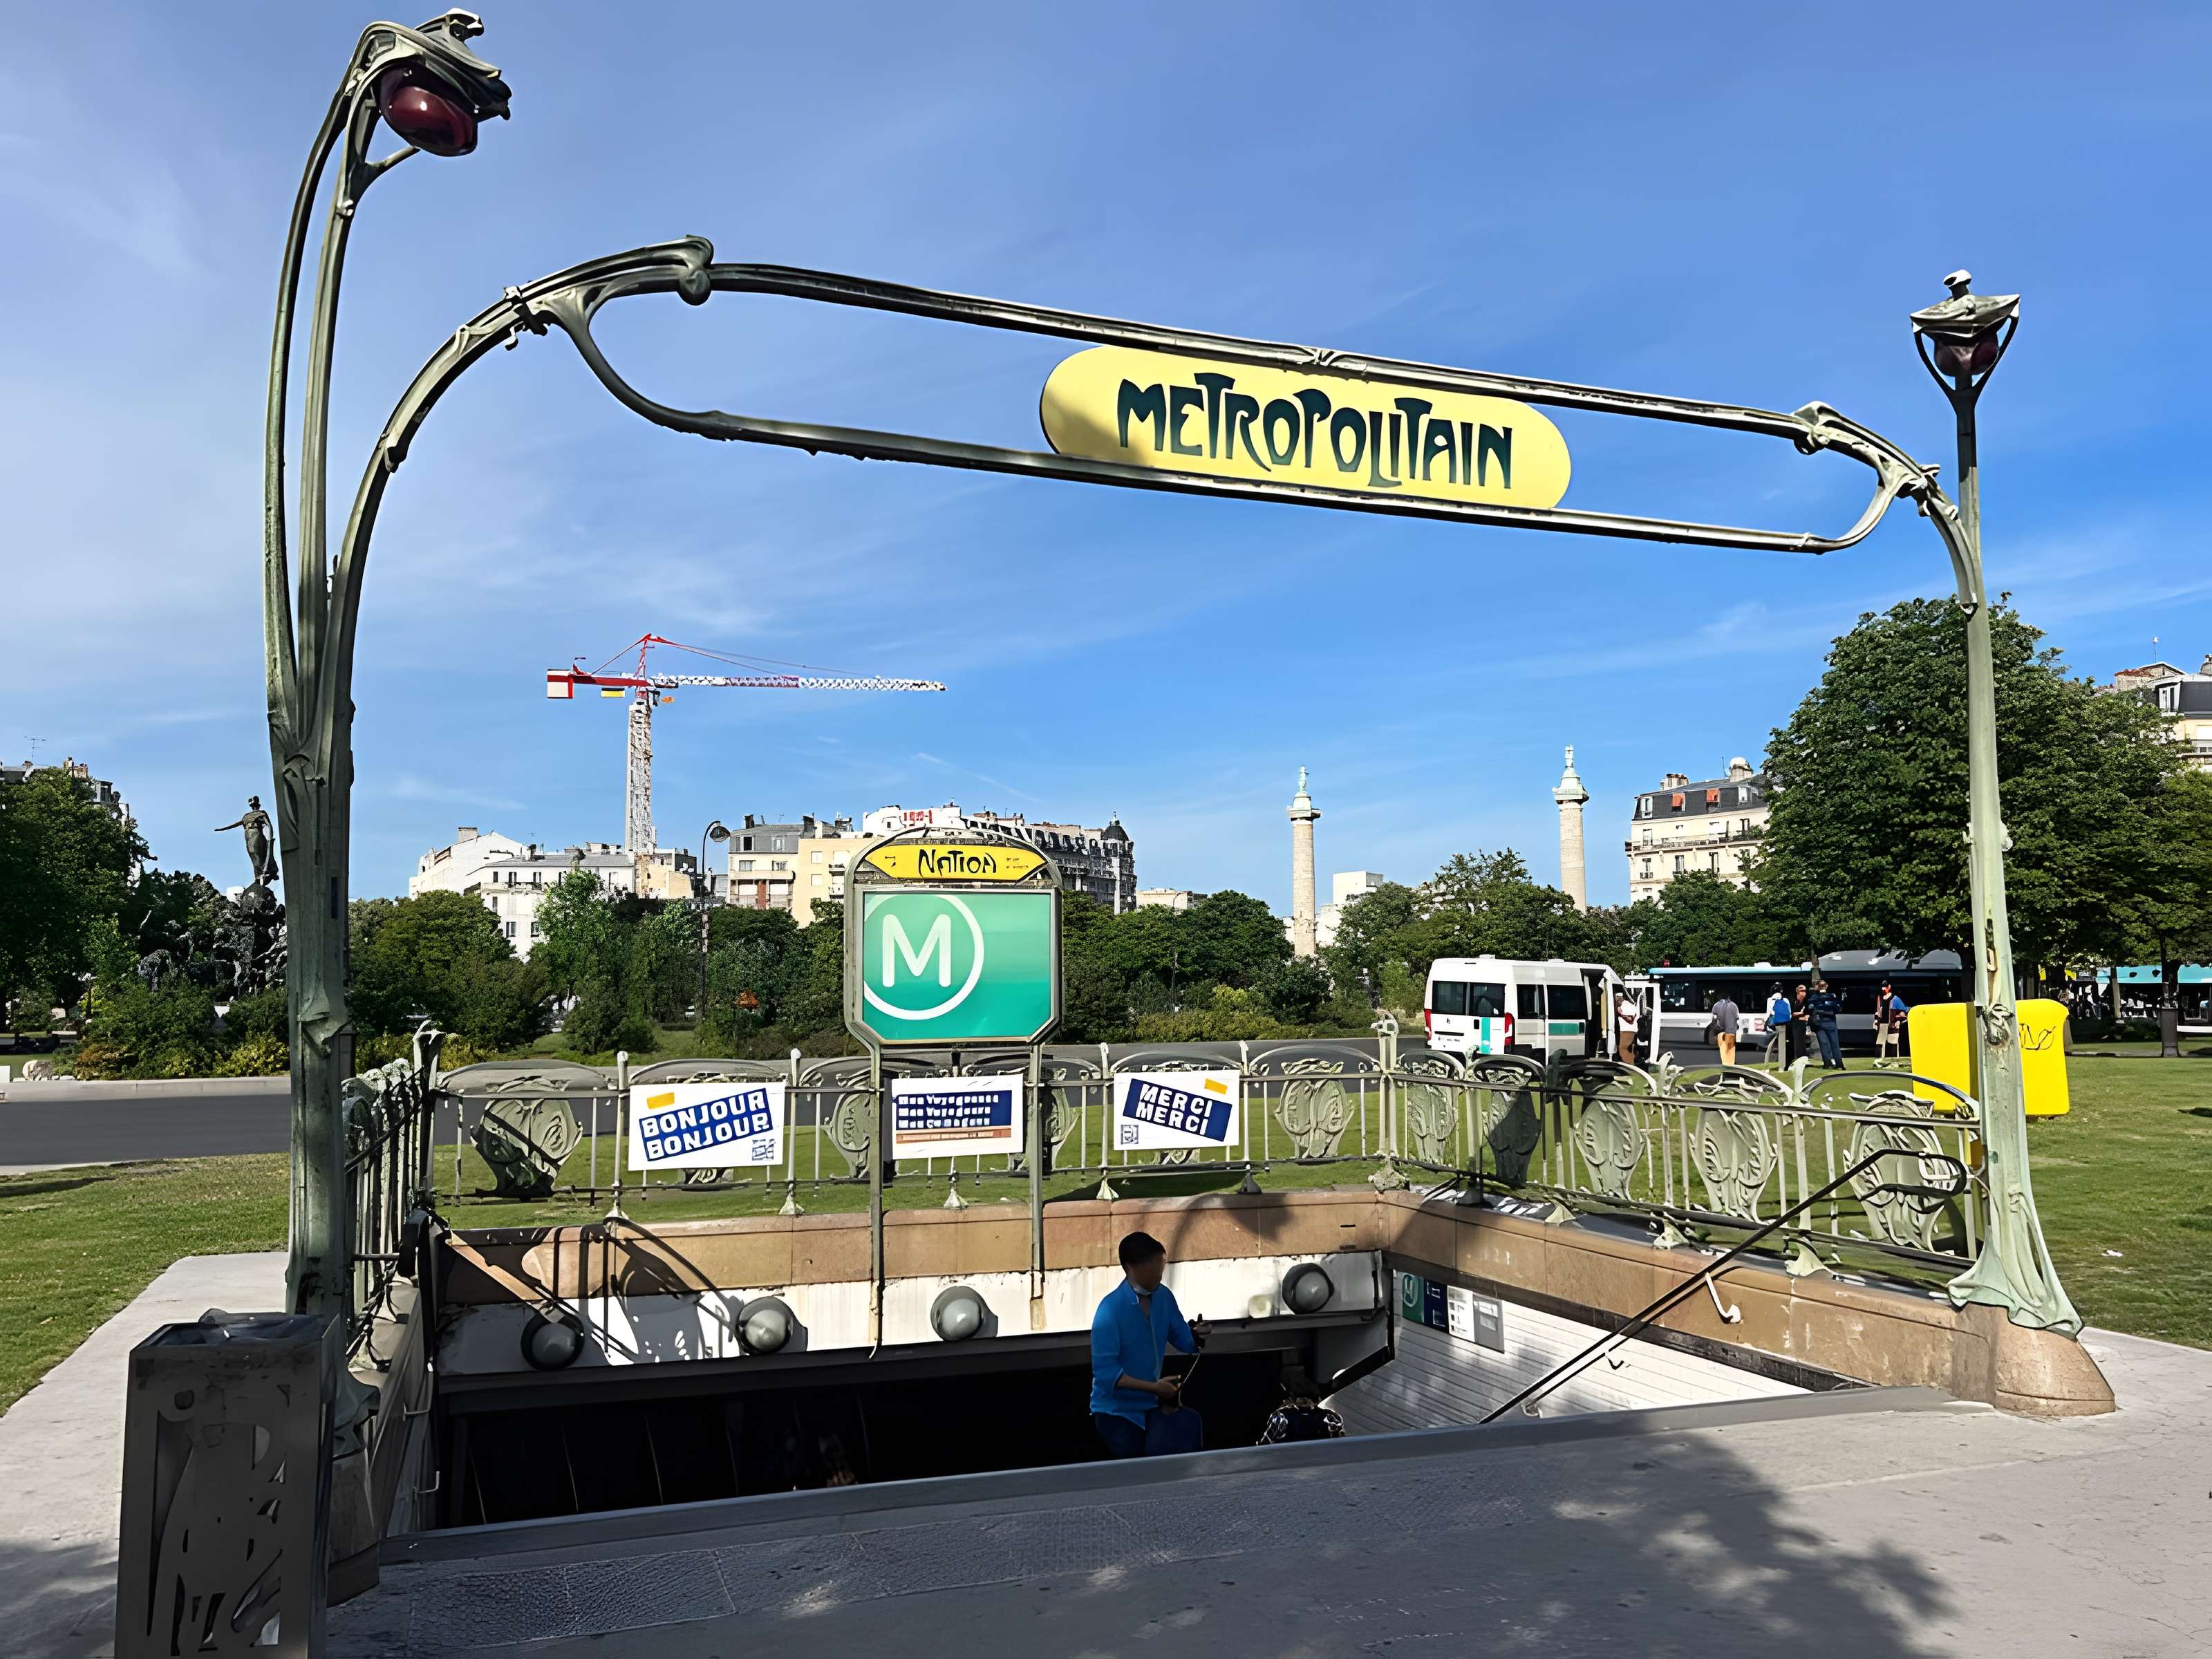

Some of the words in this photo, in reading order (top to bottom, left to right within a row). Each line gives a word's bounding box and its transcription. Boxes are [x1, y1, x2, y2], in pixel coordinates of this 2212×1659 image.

[1117, 372, 1512, 489] METROPOLITAIN
[882, 913, 952, 988] M
[641, 1091, 766, 1138] BONJOUR
[1135, 1102, 1209, 1136] MERCI
[1139, 1083, 1213, 1118] MERCI
[646, 1112, 770, 1160] BONJOUR
